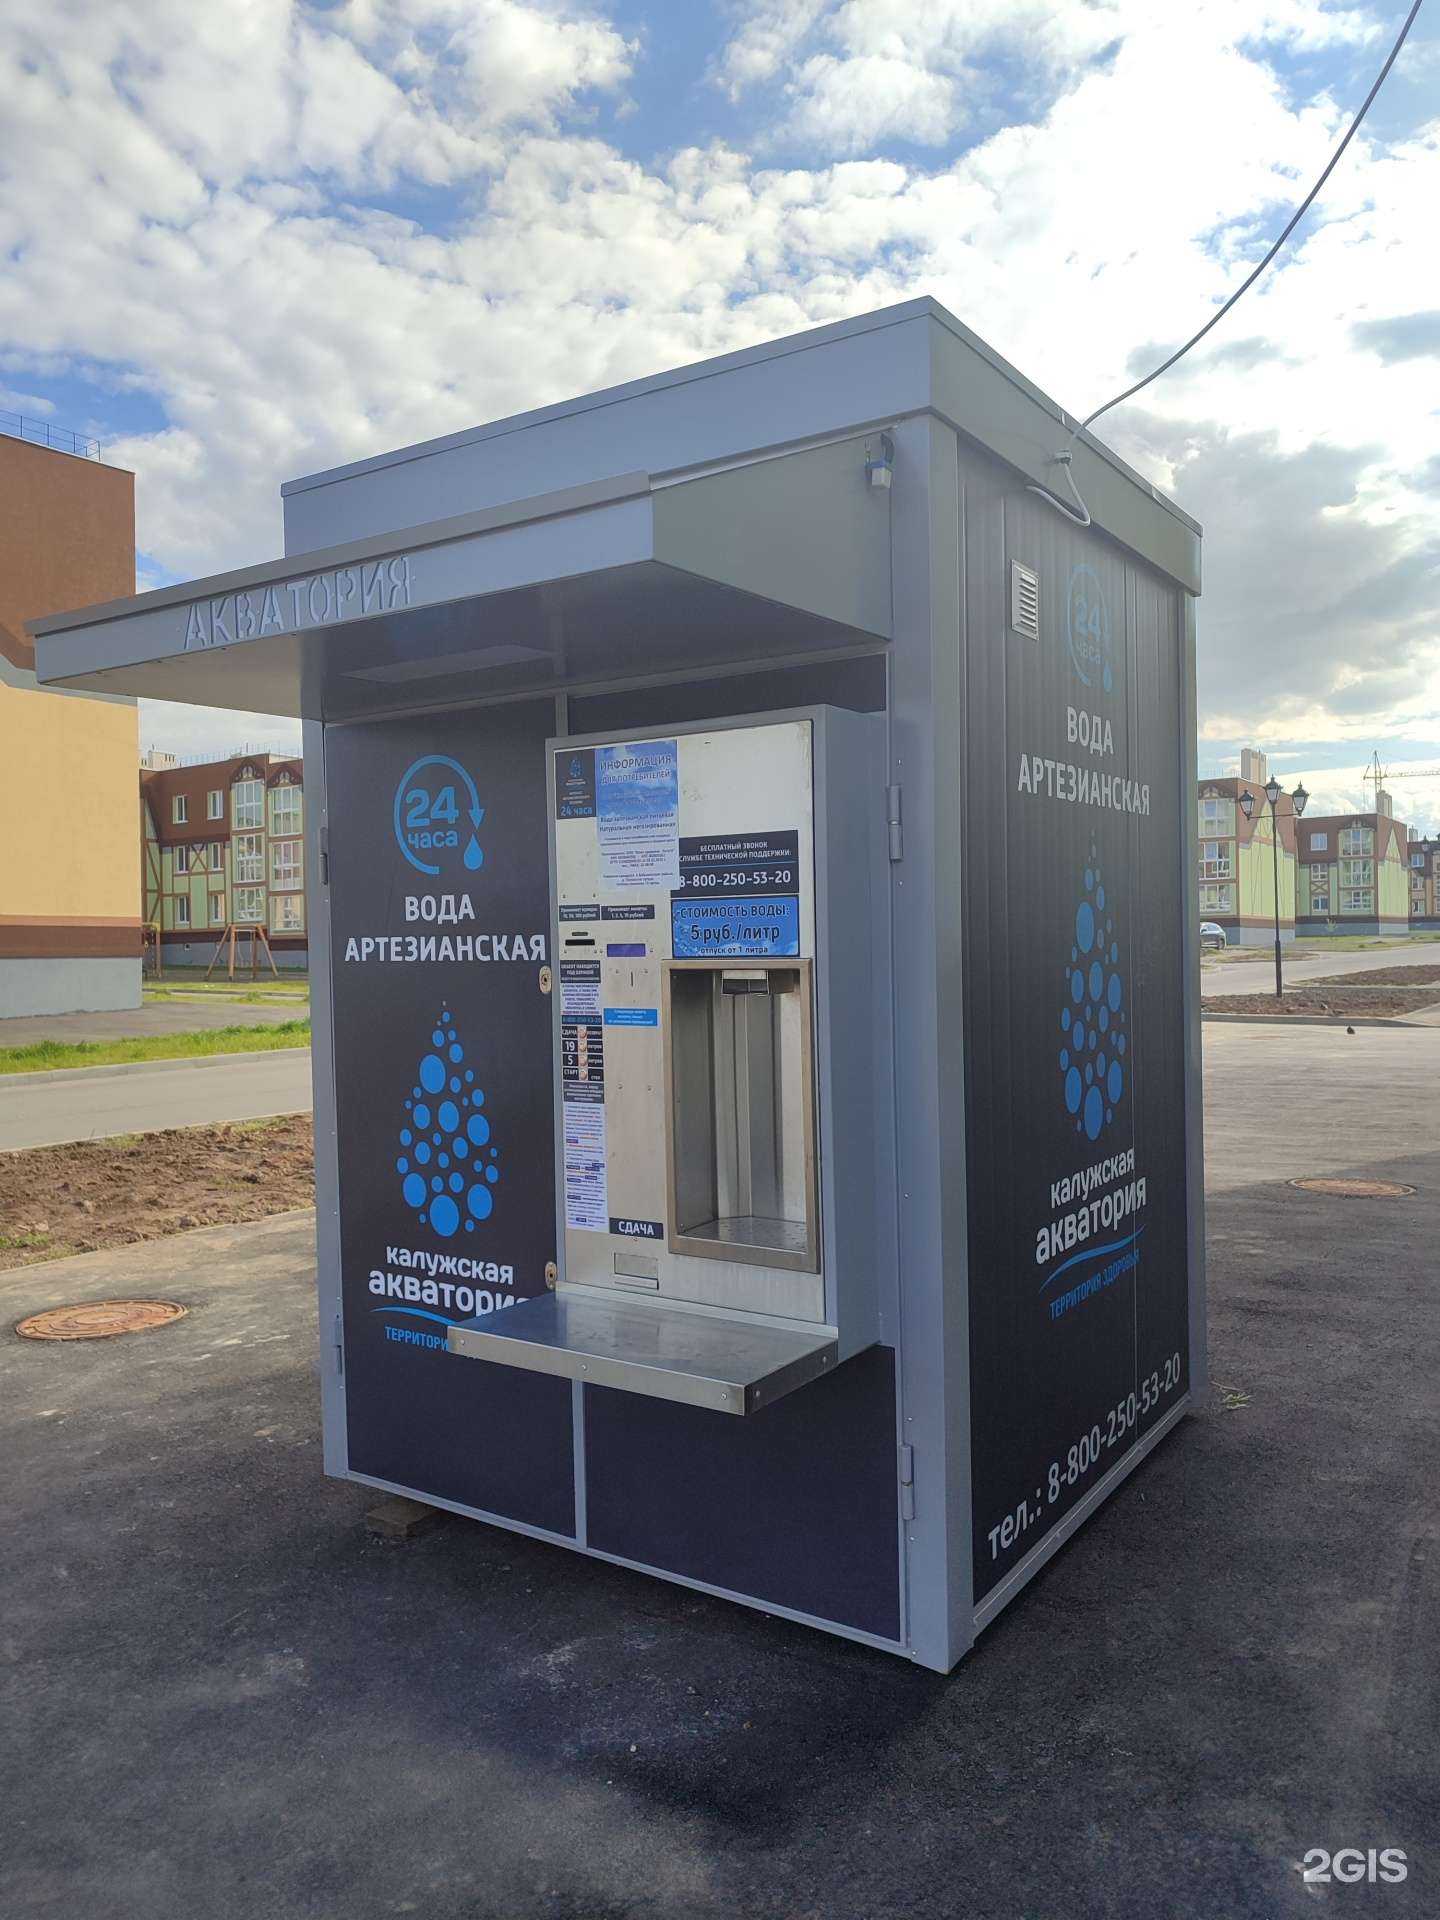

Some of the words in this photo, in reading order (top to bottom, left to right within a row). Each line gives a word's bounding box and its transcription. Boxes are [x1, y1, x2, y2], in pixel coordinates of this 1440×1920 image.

[183, 556, 411, 650] АКВАТОРИЯ
[1066, 705, 1114, 757] ВОДА
[600, 755, 672, 771] ИНФОРМАЦИЯ
[1017, 753, 1150, 816] АРТЕЗИАНСКАЯ
[405, 786, 460, 828] 24
[407, 829, 459, 849] часа
[700, 842, 742, 852] БЕСПЛАТНЫЙ
[743, 841, 768, 850] ЗВОНОК
[704, 851, 748, 861] ТЕХНИЧЕСКОЙ
[680, 870, 791, 888] 8-800-250-53-20
[404, 894, 476, 925] ВОДА
[680, 906, 748, 918] СТОИМОСТЬ
[751, 904, 790, 918] ВОДЫ:
[690, 924, 700, 940] 5
[703, 923, 780, 944] руб./литр
[344, 934, 547, 962] АРТЕЗИАНСКАЯ
[565, 1041, 575, 1052] 19
[567, 1055, 574, 1065] 5
[1051, 1147, 1135, 1209] калужская
[618, 1220, 655, 1236] СДАЧА
[1035, 1176, 1147, 1265] акватория
[386, 1246, 514, 1285] калужская
[1050, 1274, 1101, 1321] ТЕРРИТОРИЯ
[384, 1325, 449, 1352] ТЕРРИТОРИ
[987, 1488, 1042, 1561] тел.:
[1047, 1352, 1181, 1504] 8-800-250-53-20
